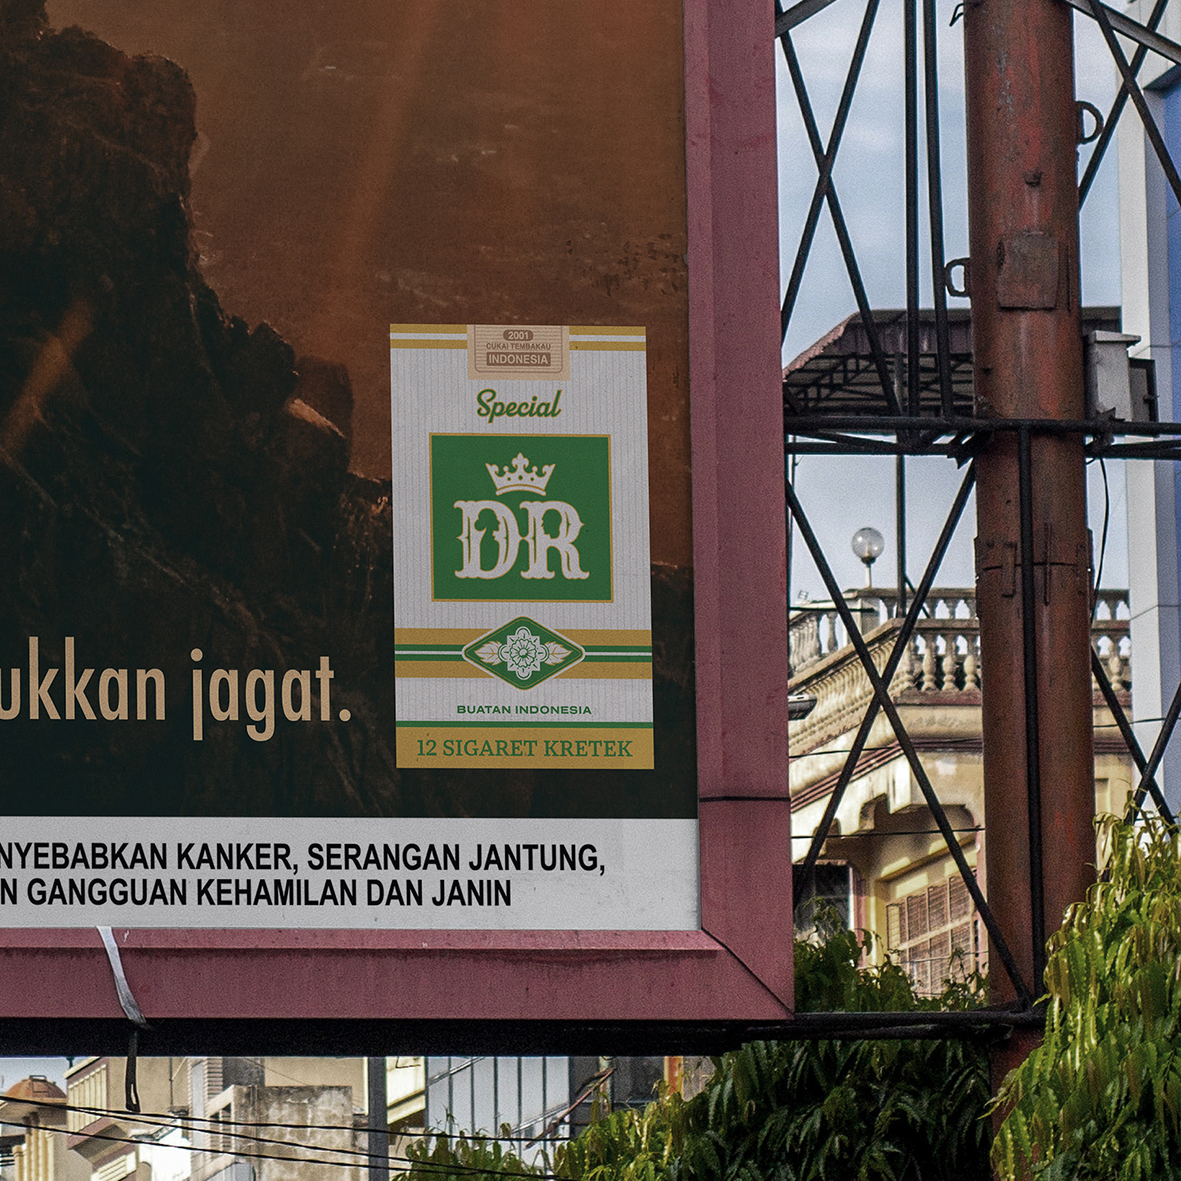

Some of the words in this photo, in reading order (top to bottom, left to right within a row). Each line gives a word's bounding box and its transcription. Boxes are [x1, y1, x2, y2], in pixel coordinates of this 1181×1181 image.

[486, 342, 509, 350] CUKAI
[511, 342, 551, 351] TEMBAKAU
[508, 331, 529, 340] 2001
[488, 354, 549, 364] INDONESIA
[476, 388, 563, 424] Special
[453, 500, 590, 580] DR
[189, 647, 352, 742] jagat.
[457, 705, 511, 714] BUATAN
[515, 705, 592, 715] INDONESIA
[417, 739, 437, 757] 12
[443, 739, 538, 757] SIGARET
[543, 740, 633, 758] KRETEK
[177, 843, 299, 875] KANKER,
[307, 843, 461, 871] SERANGAN
[469, 844, 606, 876] JANTUNG,
[27, 879, 187, 906] GANGGUAN
[197, 879, 358, 906] KEHAMILAN
[367, 880, 423, 906] DAN
[432, 880, 512, 906] JANIN
